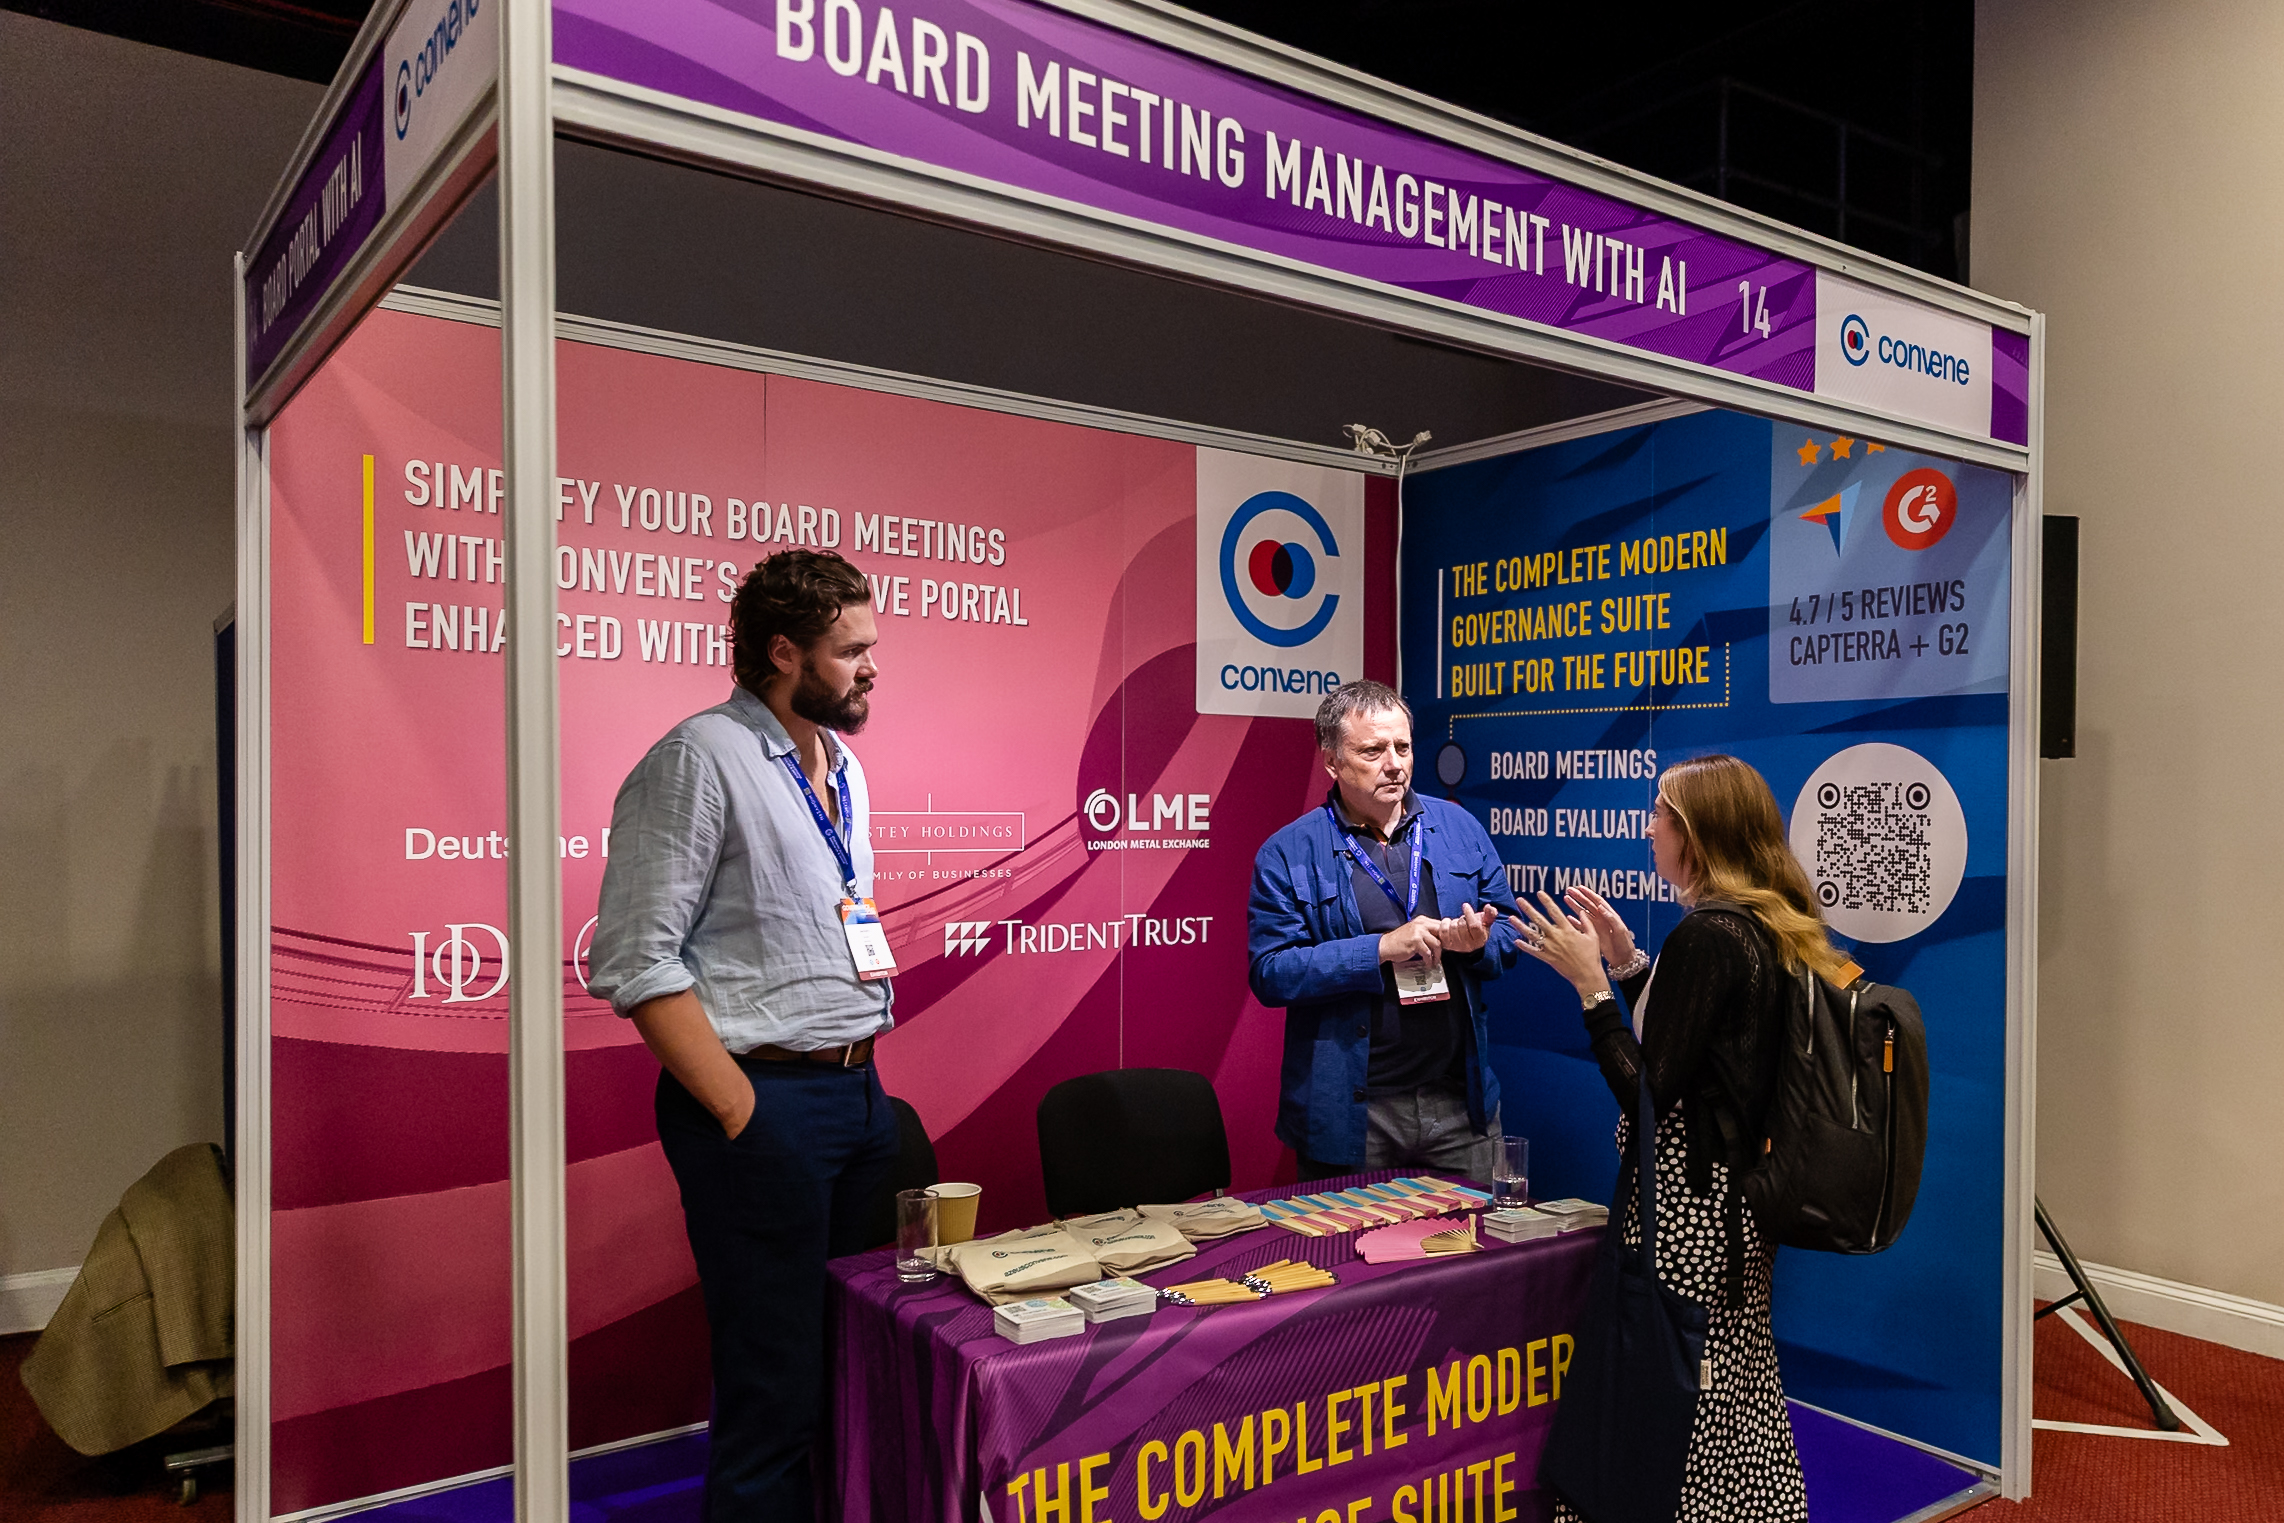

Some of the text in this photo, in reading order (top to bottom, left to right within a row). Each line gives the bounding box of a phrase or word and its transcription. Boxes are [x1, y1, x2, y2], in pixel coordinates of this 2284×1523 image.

[776, 0, 1686, 316] BOARD MEETING MANAGEMENT WITH AI
[263, 131, 361, 334] BOARD PORTAL WITH AI
[1738, 280, 1770, 339] 14
[1878, 335, 1970, 386] convene
[404, 459, 1006, 566] SIMPFY YOUR BOARD MEETINGS
[404, 530, 505, 583] WITH
[556, 545, 738, 603] ONVENE'S
[921, 579, 1028, 626] PORTAL
[1452, 527, 1727, 597] THE COMPLETE MODERN
[1452, 593, 1671, 648] GOVERNANCE SUITE
[1789, 579, 1965, 625] 4.7 / 5 REVIEWS
[637, 618, 727, 666] WITH
[1790, 622, 1969, 666] CAPTERRA + G2
[1220, 664, 1340, 695] convene
[1451, 646, 1710, 698] BUILT FOR THE FUTURE
[1490, 748, 1657, 780] BOARD MEETINGS
[921, 825, 1013, 838] HOLDINGS
[1128, 793, 1210, 831] LME
[1490, 808, 1653, 840] BOARD EVALUATI
[1087, 838, 1210, 851] LONDON METAL EXCHANGE
[873, 869, 1012, 880] MILY OF BUSINESSES
[1007, 1333, 1575, 1523] THE COMPLETE MODER
[1392, 1452, 1517, 1523] SUITE
